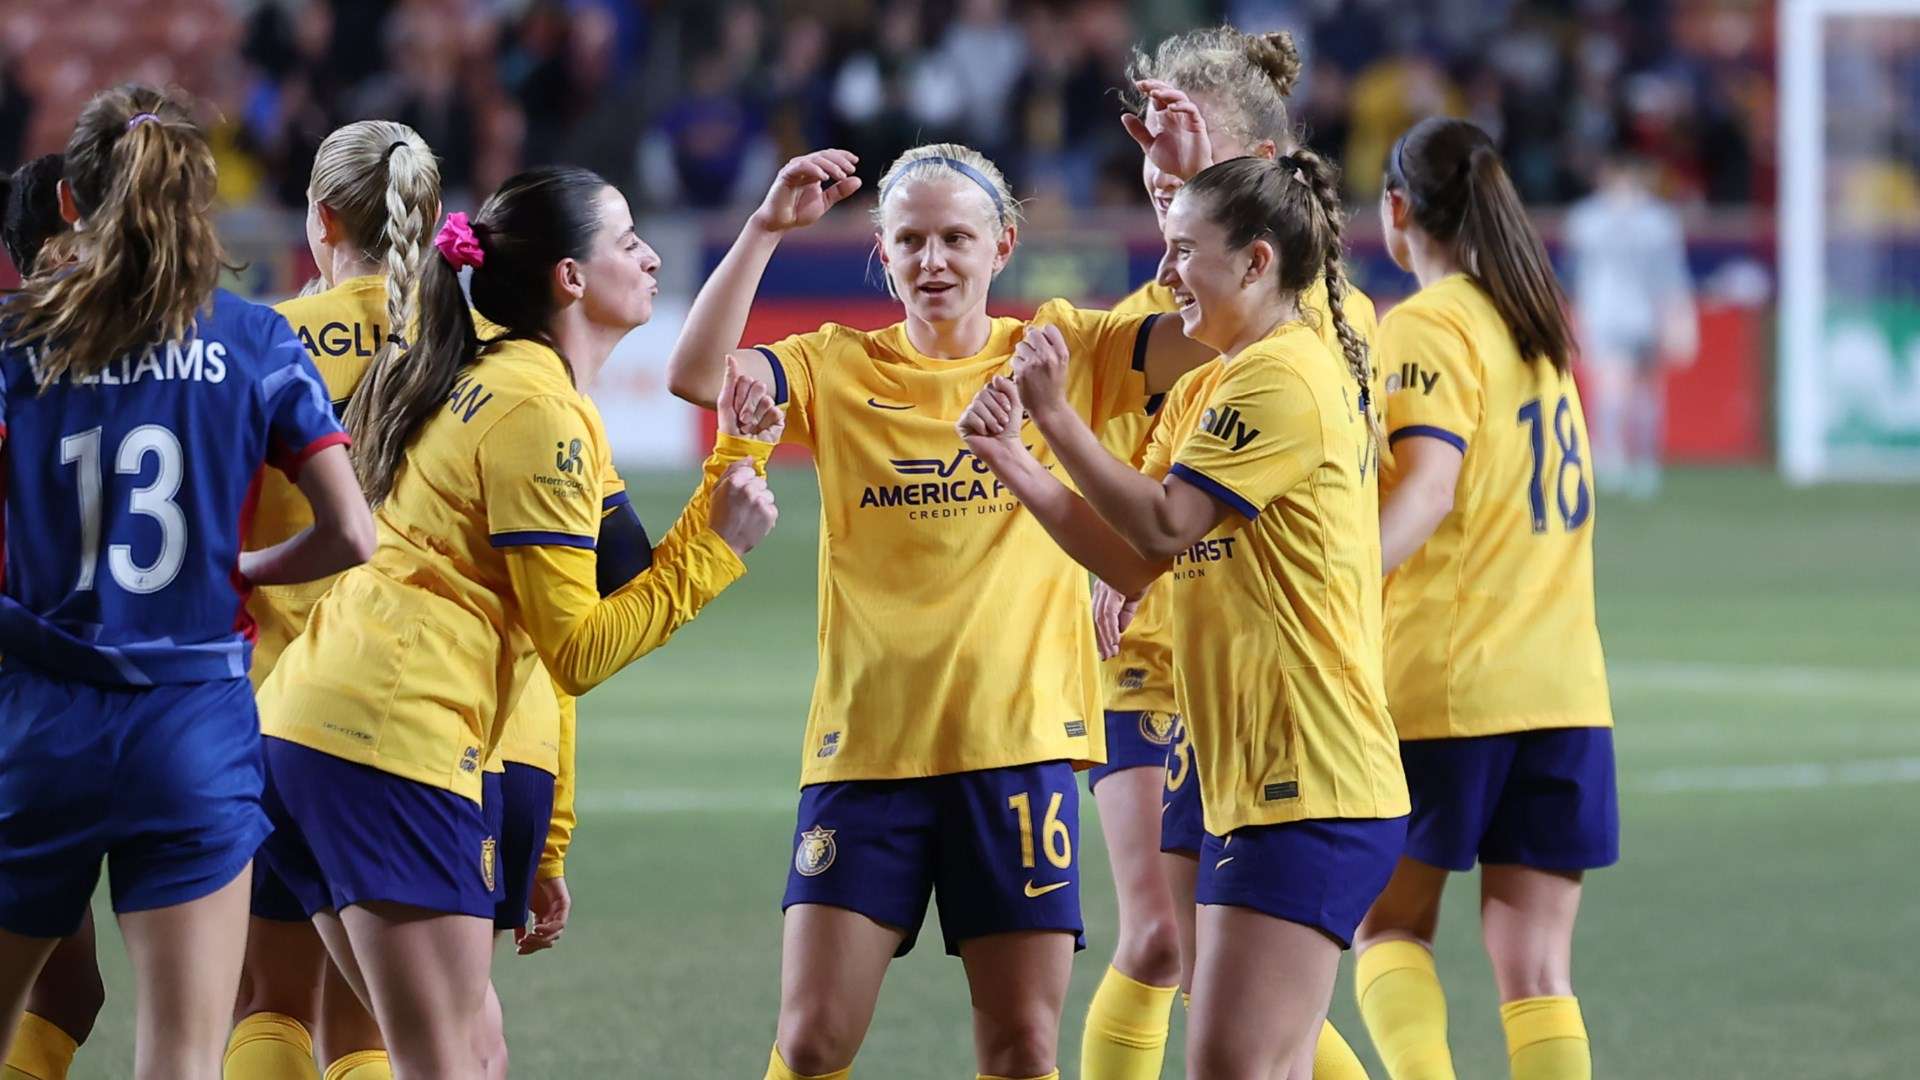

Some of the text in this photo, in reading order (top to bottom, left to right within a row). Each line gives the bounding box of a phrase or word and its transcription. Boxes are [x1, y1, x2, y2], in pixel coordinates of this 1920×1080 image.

[1201, 404, 1261, 451] ally
[860, 479, 988, 509] AMERICA
[1518, 396, 1590, 532] 18
[61, 424, 188, 594] 13
[909, 507, 968, 520] CREDIT
[1008, 792, 1072, 869] 16
